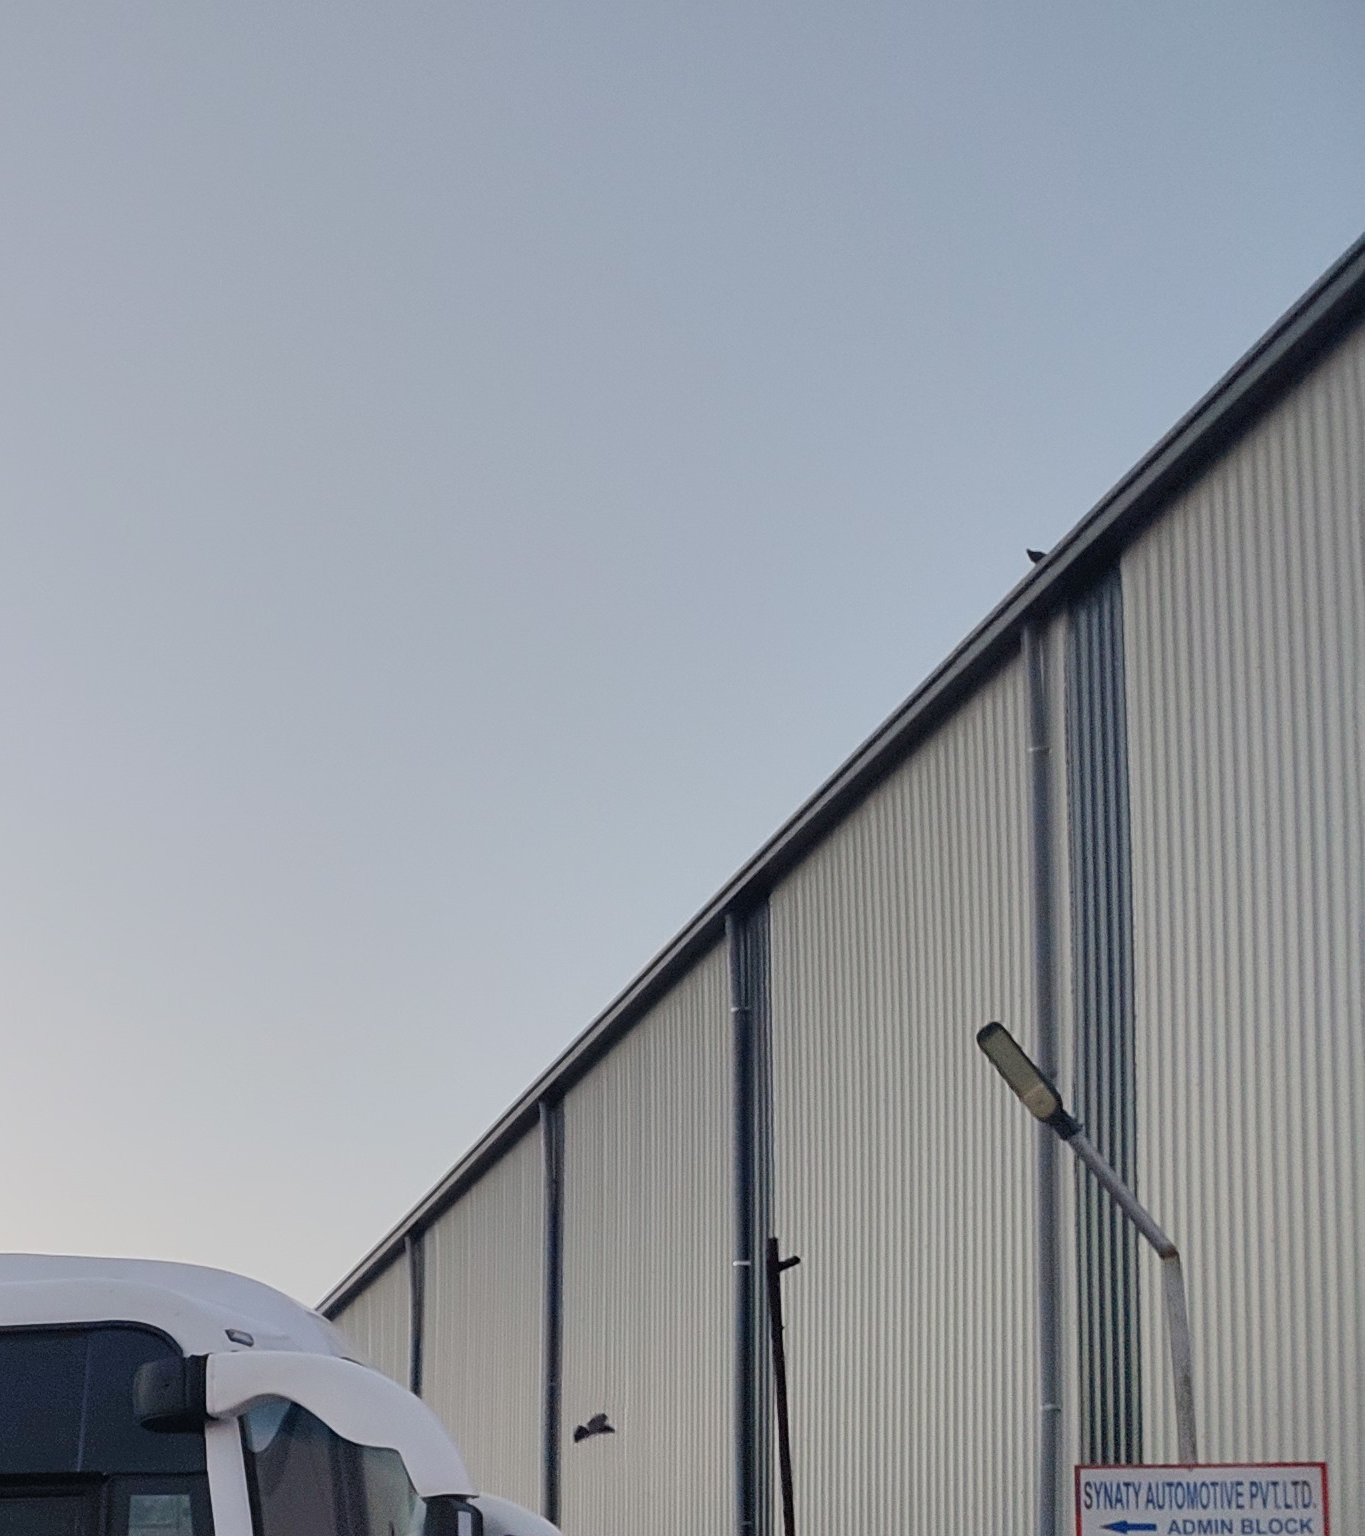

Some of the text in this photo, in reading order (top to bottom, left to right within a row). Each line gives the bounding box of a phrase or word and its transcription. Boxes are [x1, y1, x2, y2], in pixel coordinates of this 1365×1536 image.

[1084, 1480, 1142, 1510] SYNATY
[1145, 1480, 1245, 1510] AUTOMOTIVE
[1167, 1517, 1315, 1536] ADMIN BLOCK
